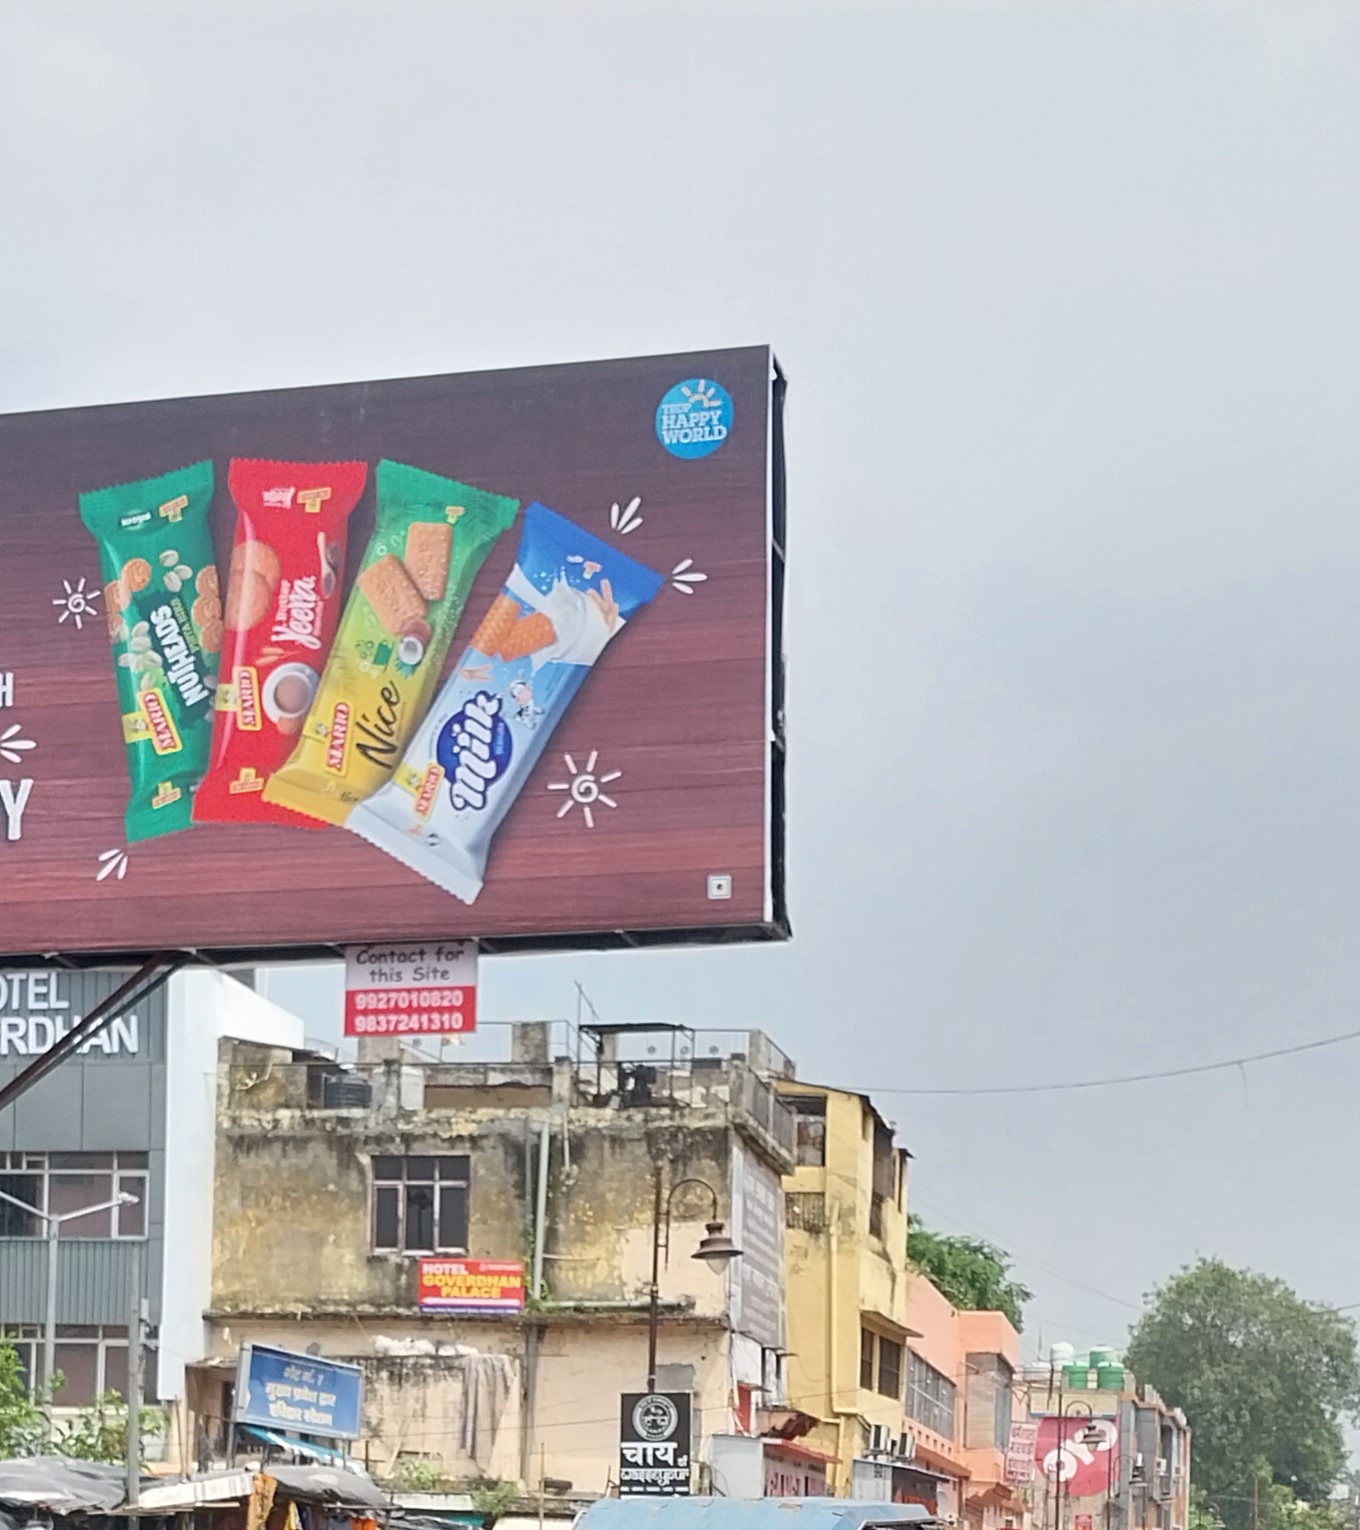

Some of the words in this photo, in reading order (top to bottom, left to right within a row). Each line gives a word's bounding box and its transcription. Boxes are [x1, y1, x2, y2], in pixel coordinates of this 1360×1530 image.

[662, 410, 722, 429] HAPPY
[662, 425, 728, 444] WORLD
[149, 605, 210, 707] NUTHEADS
[240, 669, 257, 728] MARIO
[143, 692, 177, 751] MARIO
[355, 680, 401, 770] Nice
[327, 702, 350, 772] MARIO
[356, 947, 427, 965] Contact
[435, 946, 465, 963] for
[369, 967, 403, 982] this
[412, 966, 450, 982] Site
[354, 1011, 463, 1032] 9837241310
[423, 1262, 469, 1275] HOTEL
[423, 1274, 522, 1288] GOVERDHAN
[441, 1286, 501, 1298] PALACE
[621, 1442, 678, 1467] चाय
